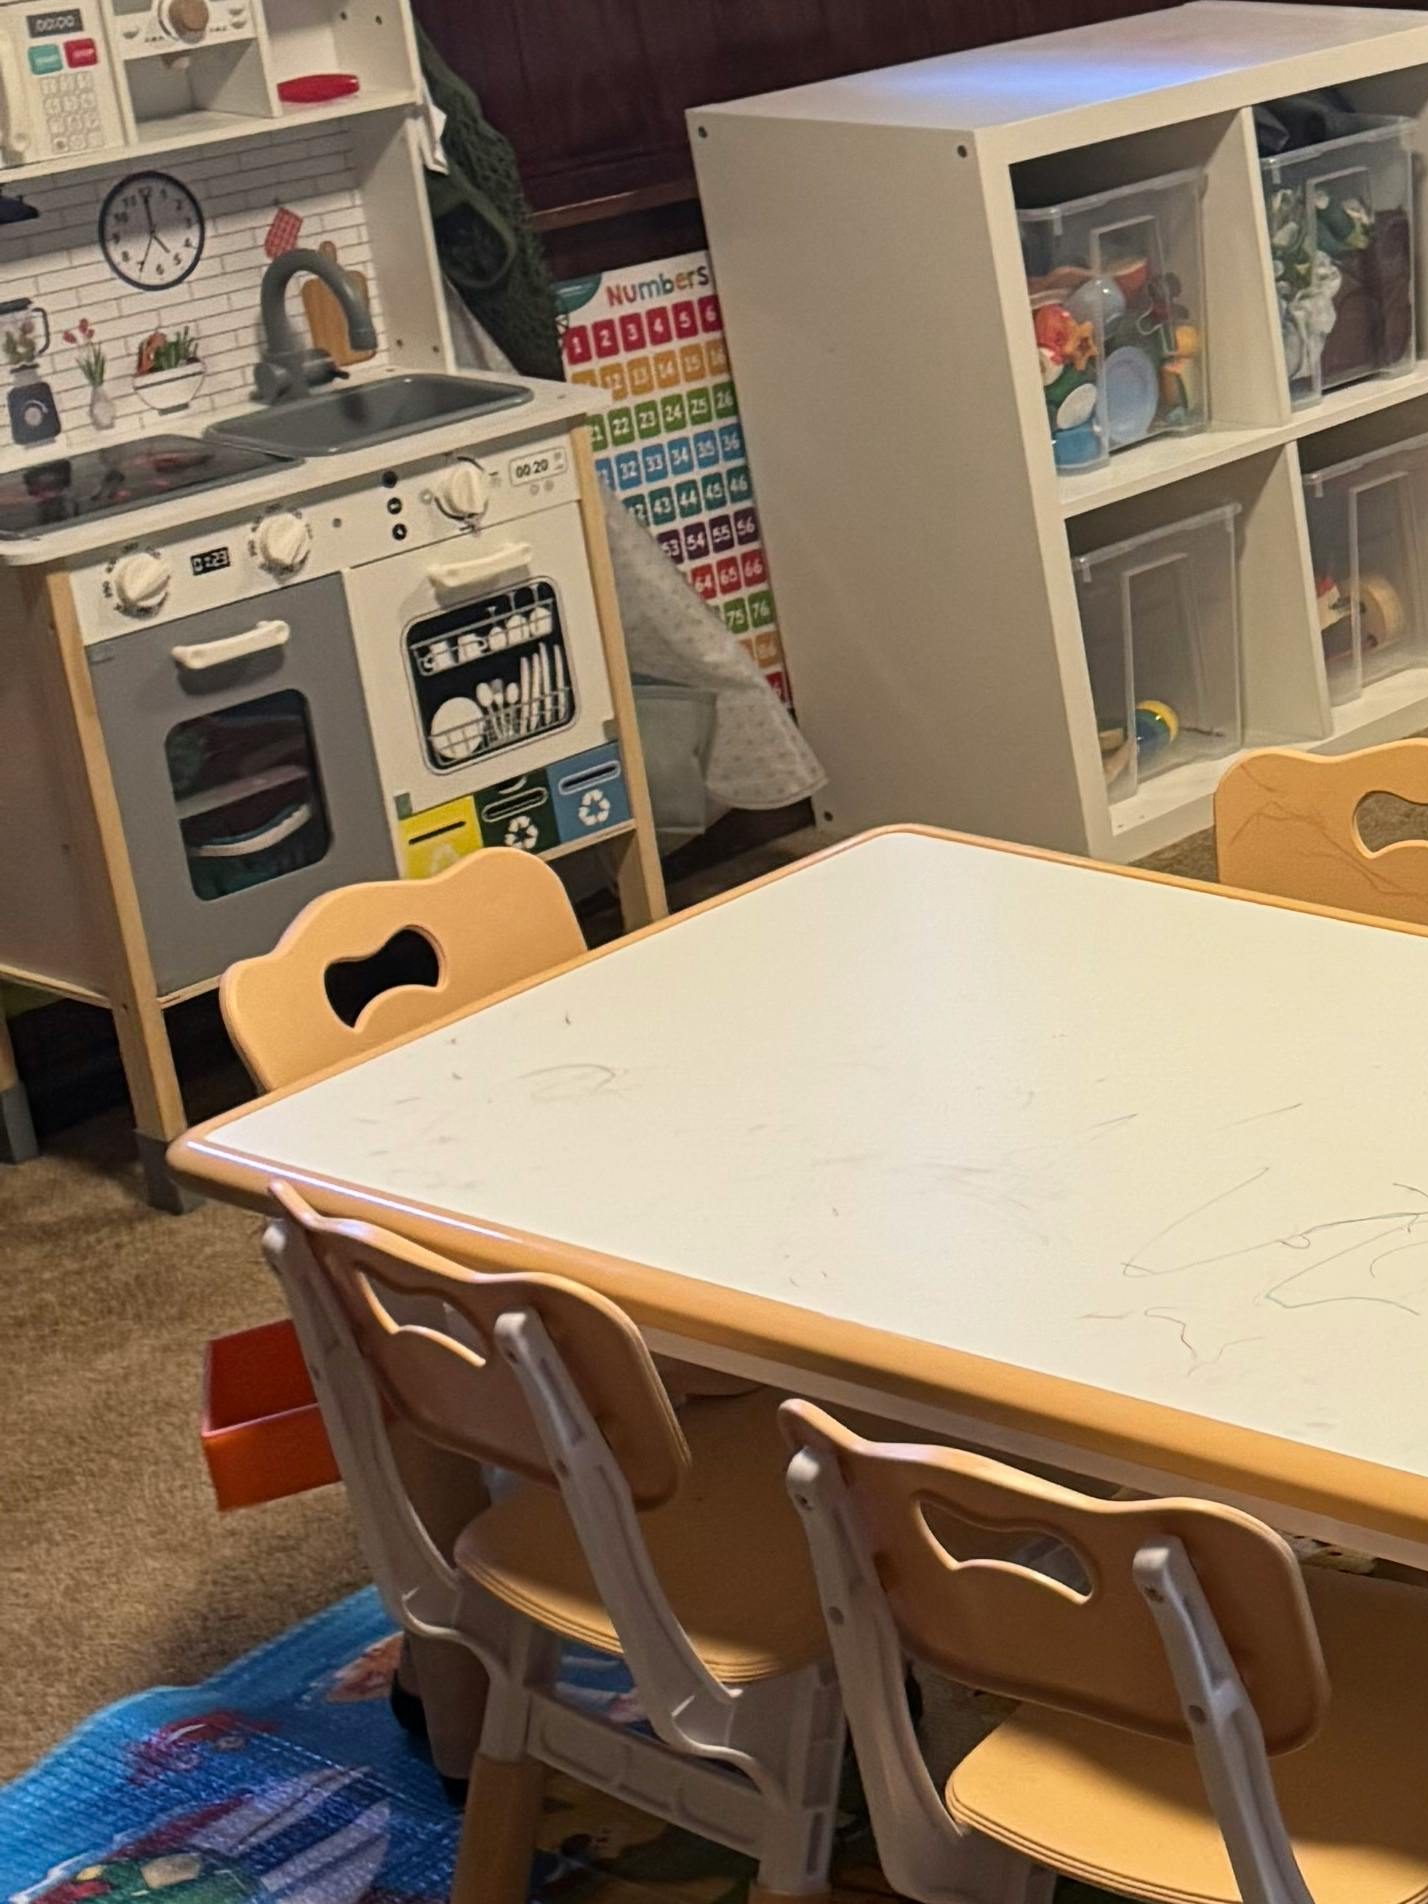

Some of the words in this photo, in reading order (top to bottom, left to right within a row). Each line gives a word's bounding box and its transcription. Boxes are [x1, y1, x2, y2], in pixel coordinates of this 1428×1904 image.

[606, 265, 710, 307] Numbers
[572, 336, 582, 354] 1
[600, 329, 611, 346] 2
[627, 324, 639, 340] 3
[654, 318, 664, 332] 4
[679, 312, 690, 328] 5
[705, 305, 716, 322] 6
[612, 418, 629, 435] 22
[639, 411, 656, 428] 23
[665, 404, 683, 421] 24
[691, 398, 708, 414] 25
[620, 462, 637, 478] 32
[646, 455, 663, 471] 33
[671, 448, 689, 464] 34
[724, 433, 740, 450] 36
[653, 497, 671, 513] 43
[679, 491, 696, 507] 44
[706, 484, 722, 498] 45
[730, 476, 747, 492] 46
[686, 534, 705, 550] 54
[713, 525, 730, 543] 55
[736, 518, 755, 535] 56
[720, 568, 737, 584] 65
[744, 560, 762, 576] 66
[727, 610, 744, 626] 75
[752, 600, 769, 618] 76
